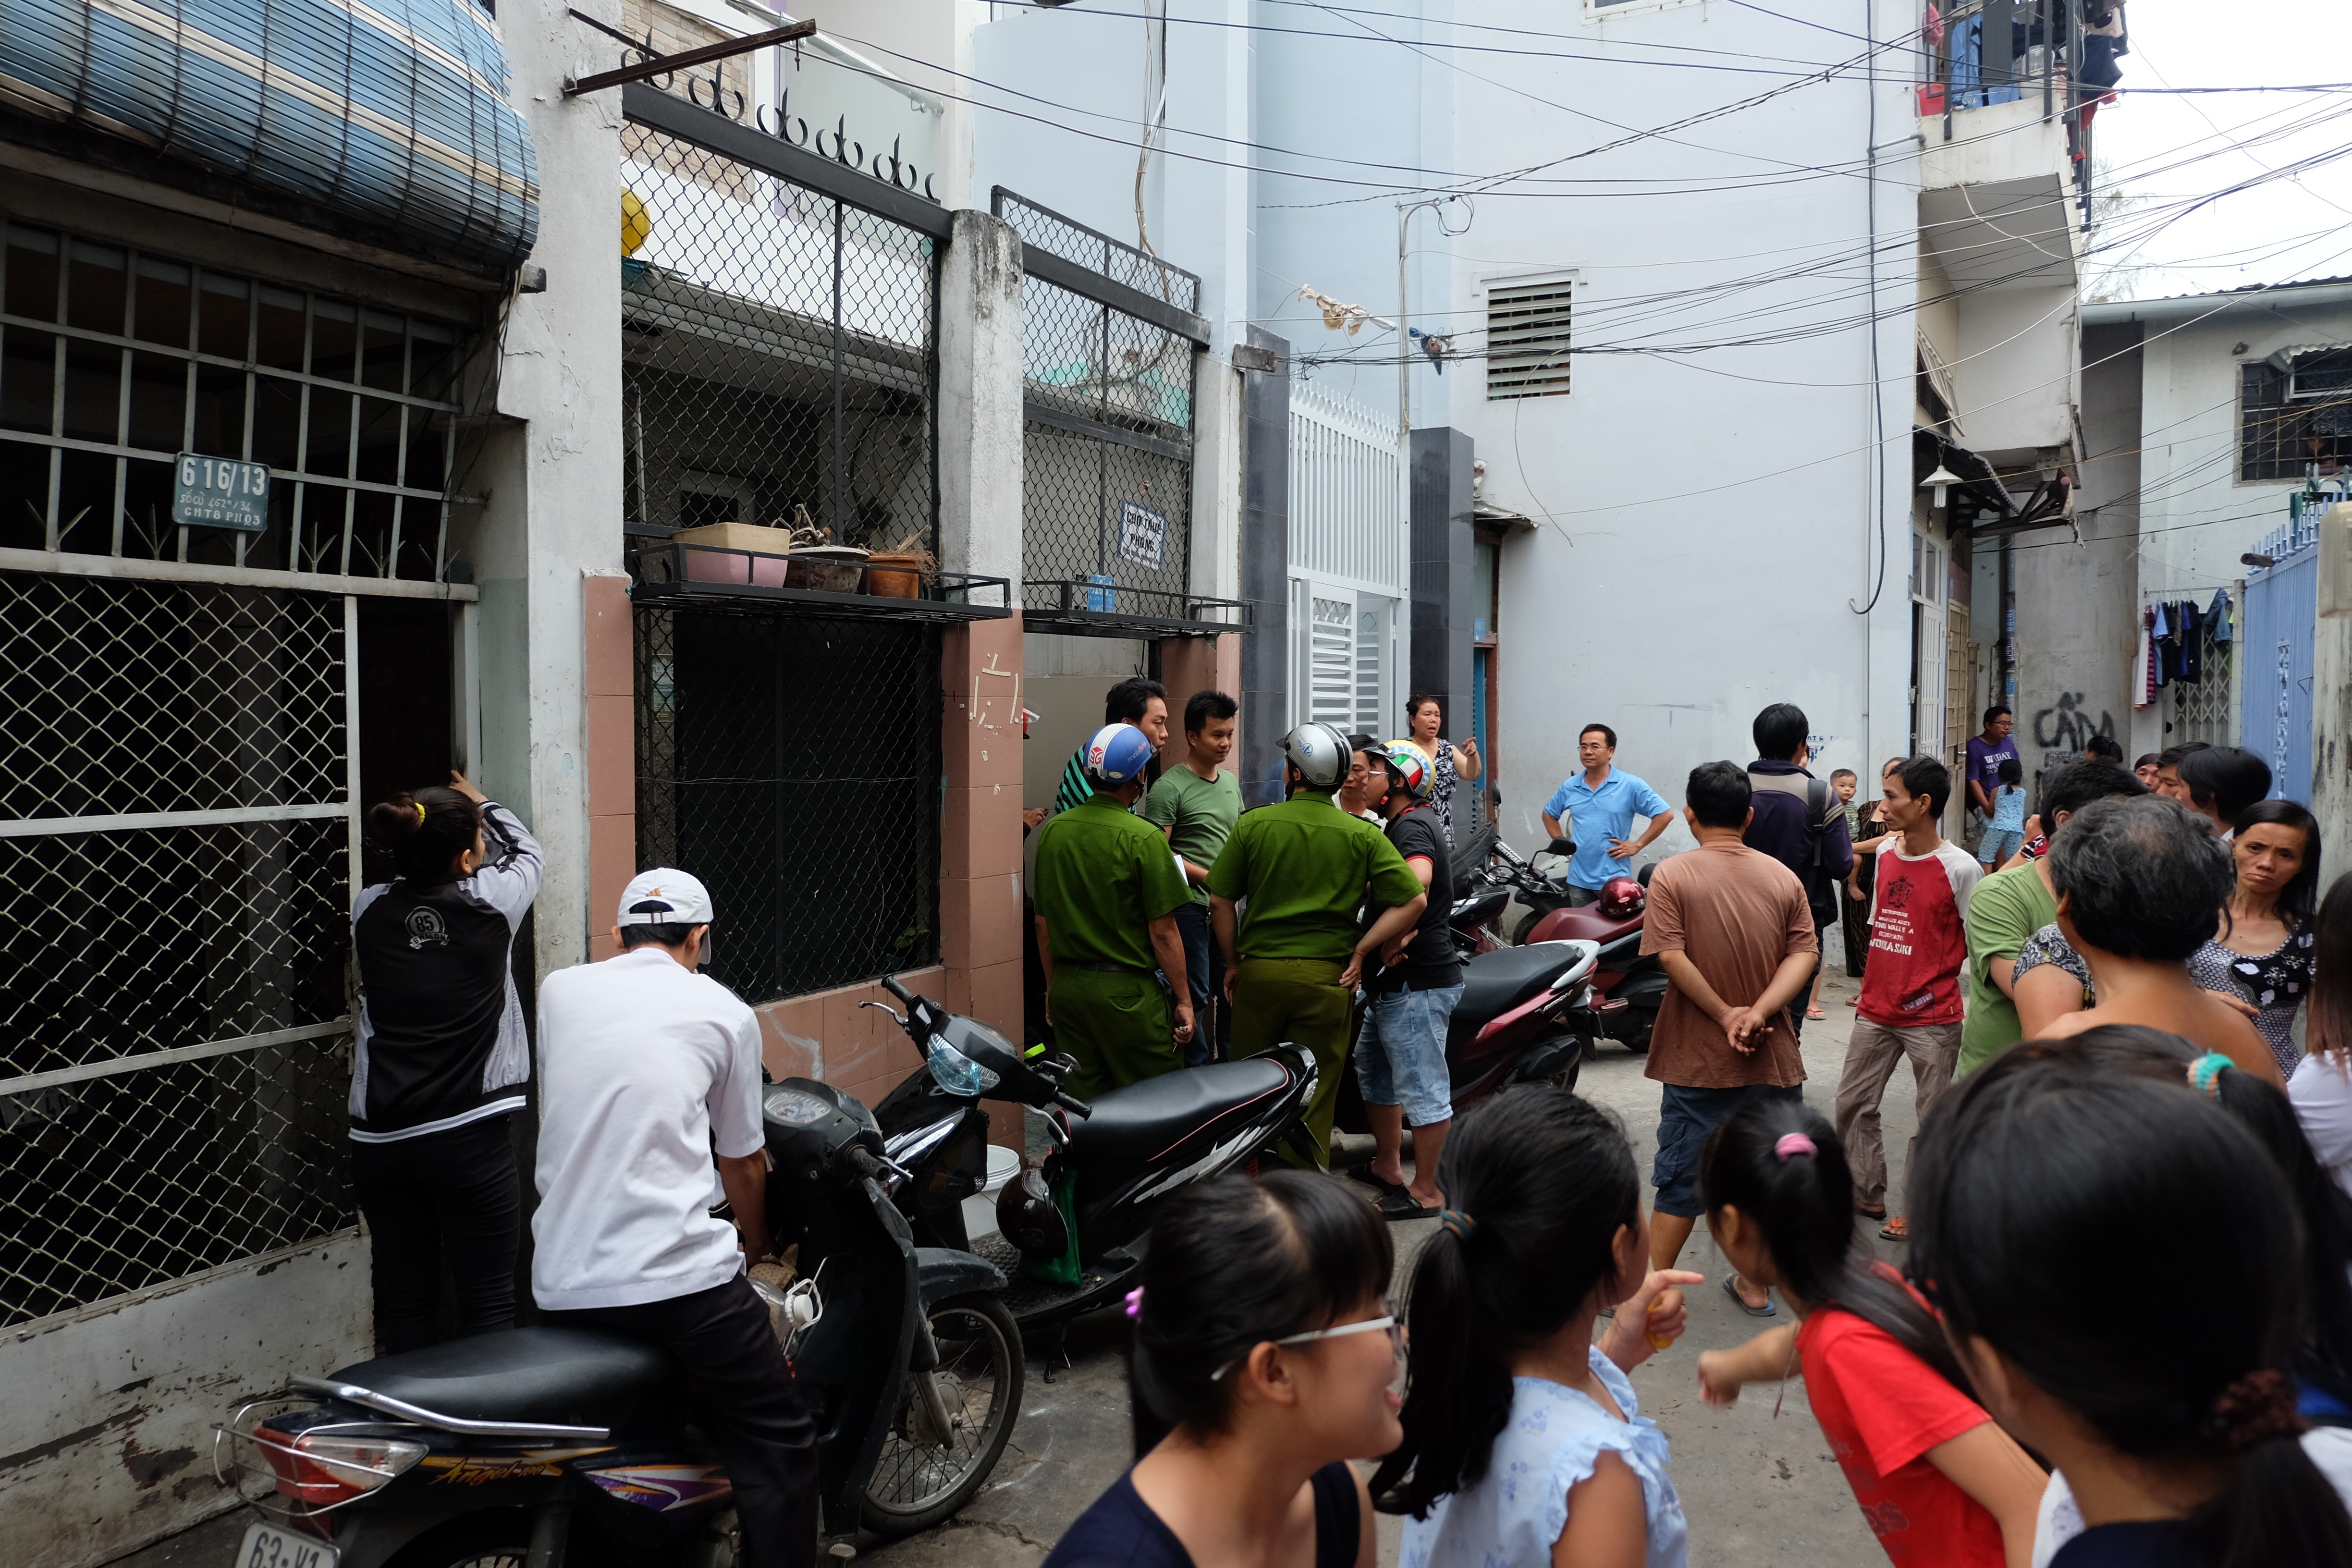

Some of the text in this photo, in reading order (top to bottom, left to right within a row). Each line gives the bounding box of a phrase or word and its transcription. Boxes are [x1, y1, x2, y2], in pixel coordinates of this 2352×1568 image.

[182, 458, 265, 497] 616/13
[415, 915, 434, 932] 85
[428, 1457, 522, 1487] Angel
